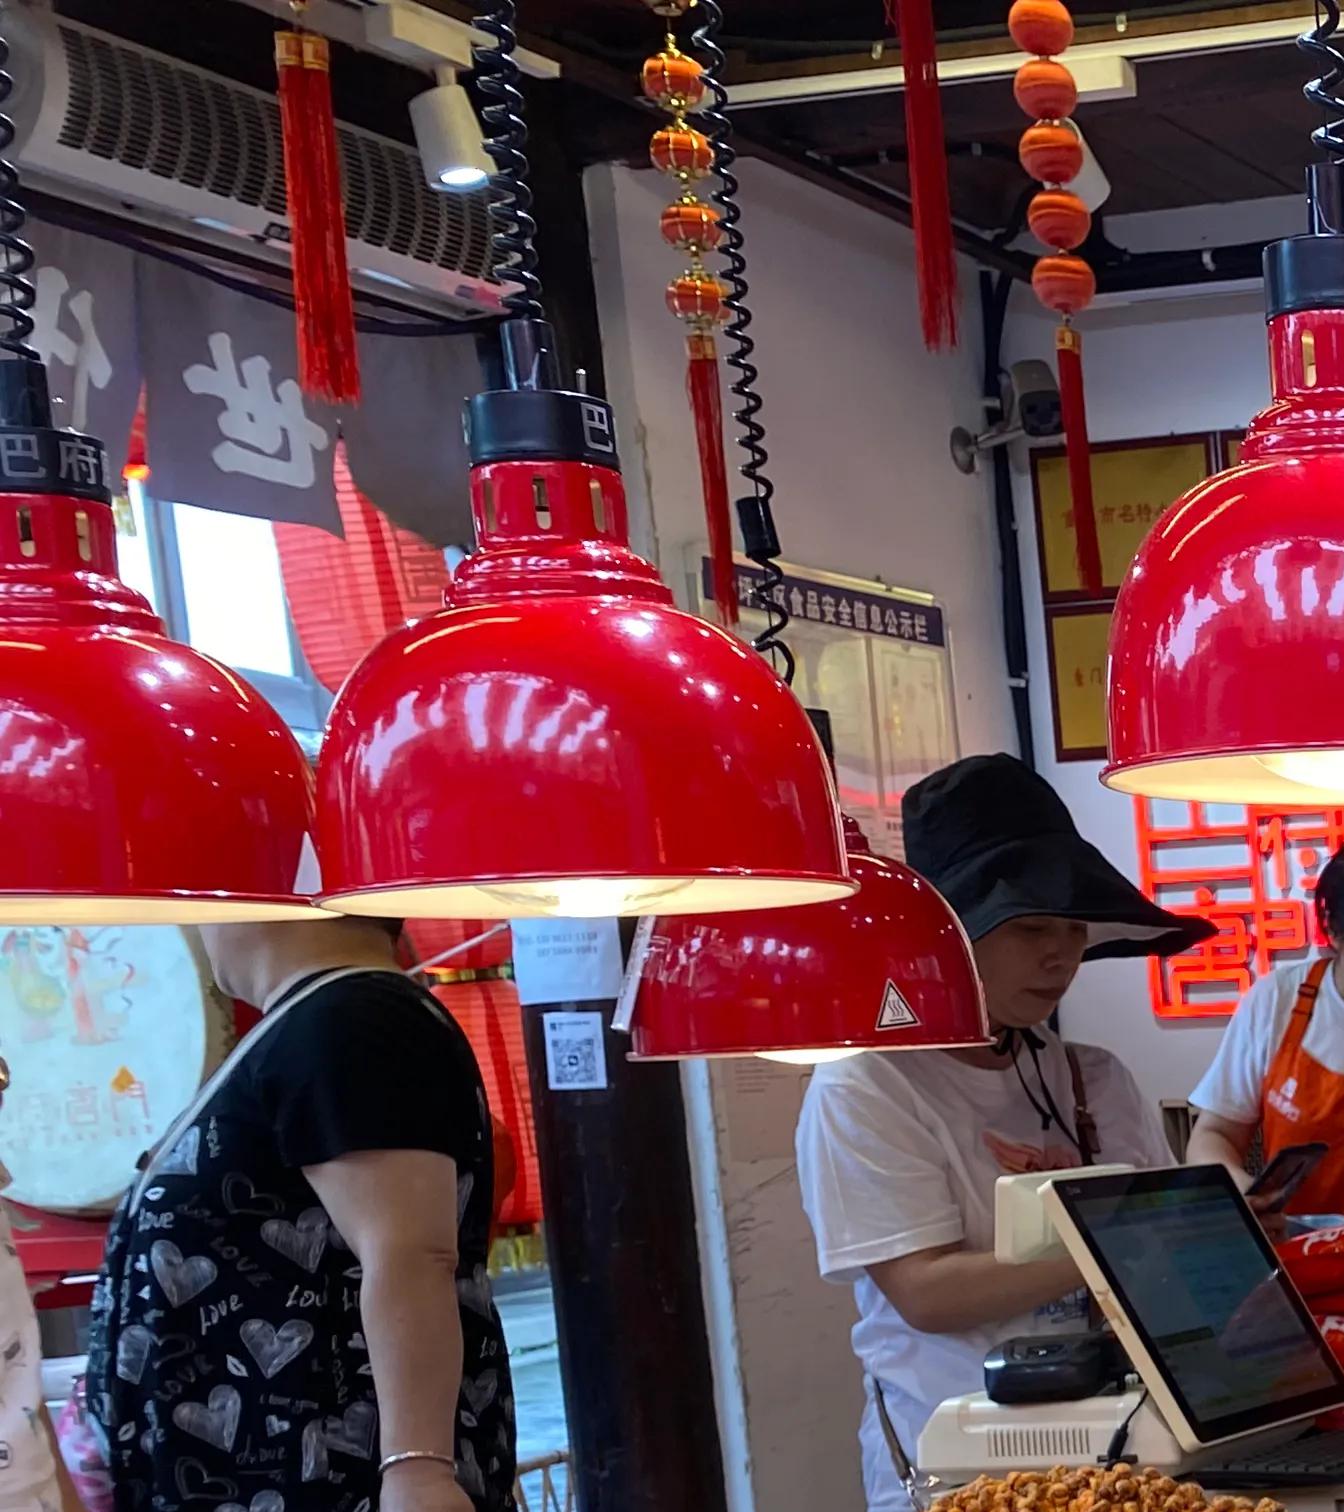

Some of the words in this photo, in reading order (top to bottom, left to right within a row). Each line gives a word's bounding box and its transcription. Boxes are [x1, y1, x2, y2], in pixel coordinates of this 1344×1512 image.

[580, 401, 614, 453] 巴
[1, 432, 112, 488] 巴府
[737, 573, 929, 642] 坪区食品安全信息公示栏
